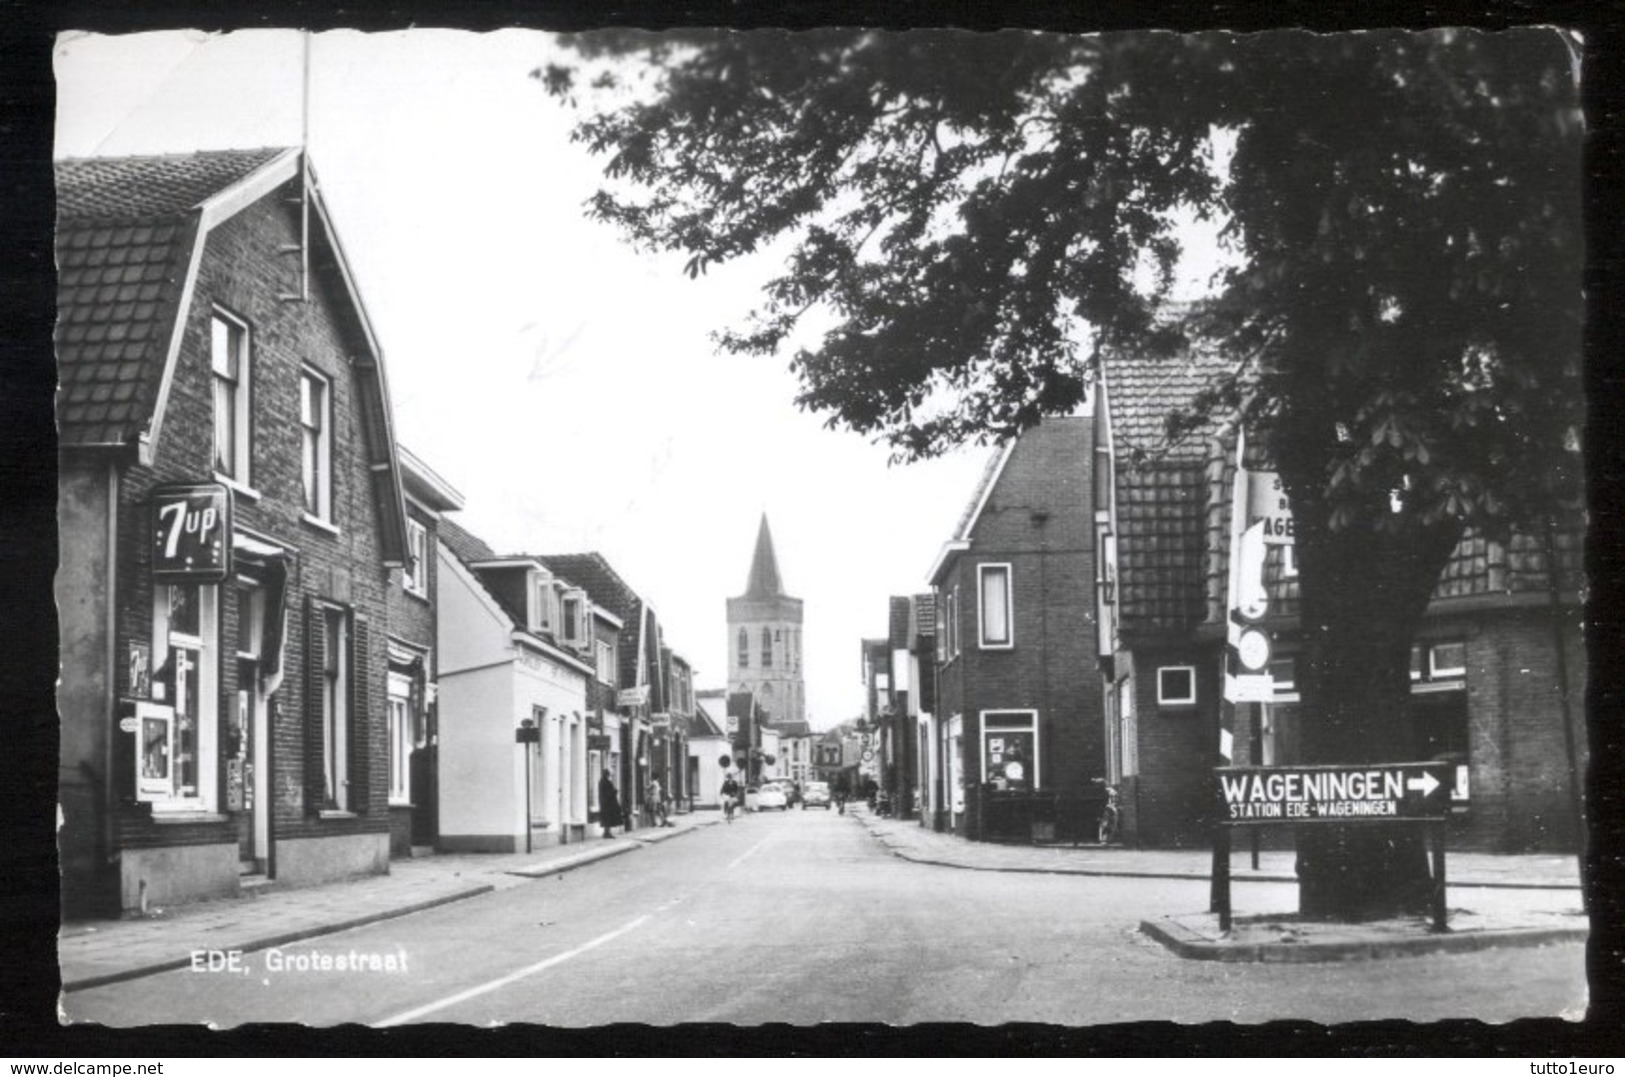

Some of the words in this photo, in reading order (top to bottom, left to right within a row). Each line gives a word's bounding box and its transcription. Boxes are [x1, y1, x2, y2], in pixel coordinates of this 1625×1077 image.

[160, 501, 216, 558] 7up
[1221, 771, 1403, 802] WAGENINGEN
[1230, 803, 1281, 818] STATION
[1286, 801, 1397, 816] EDE-WAGENINGEN
